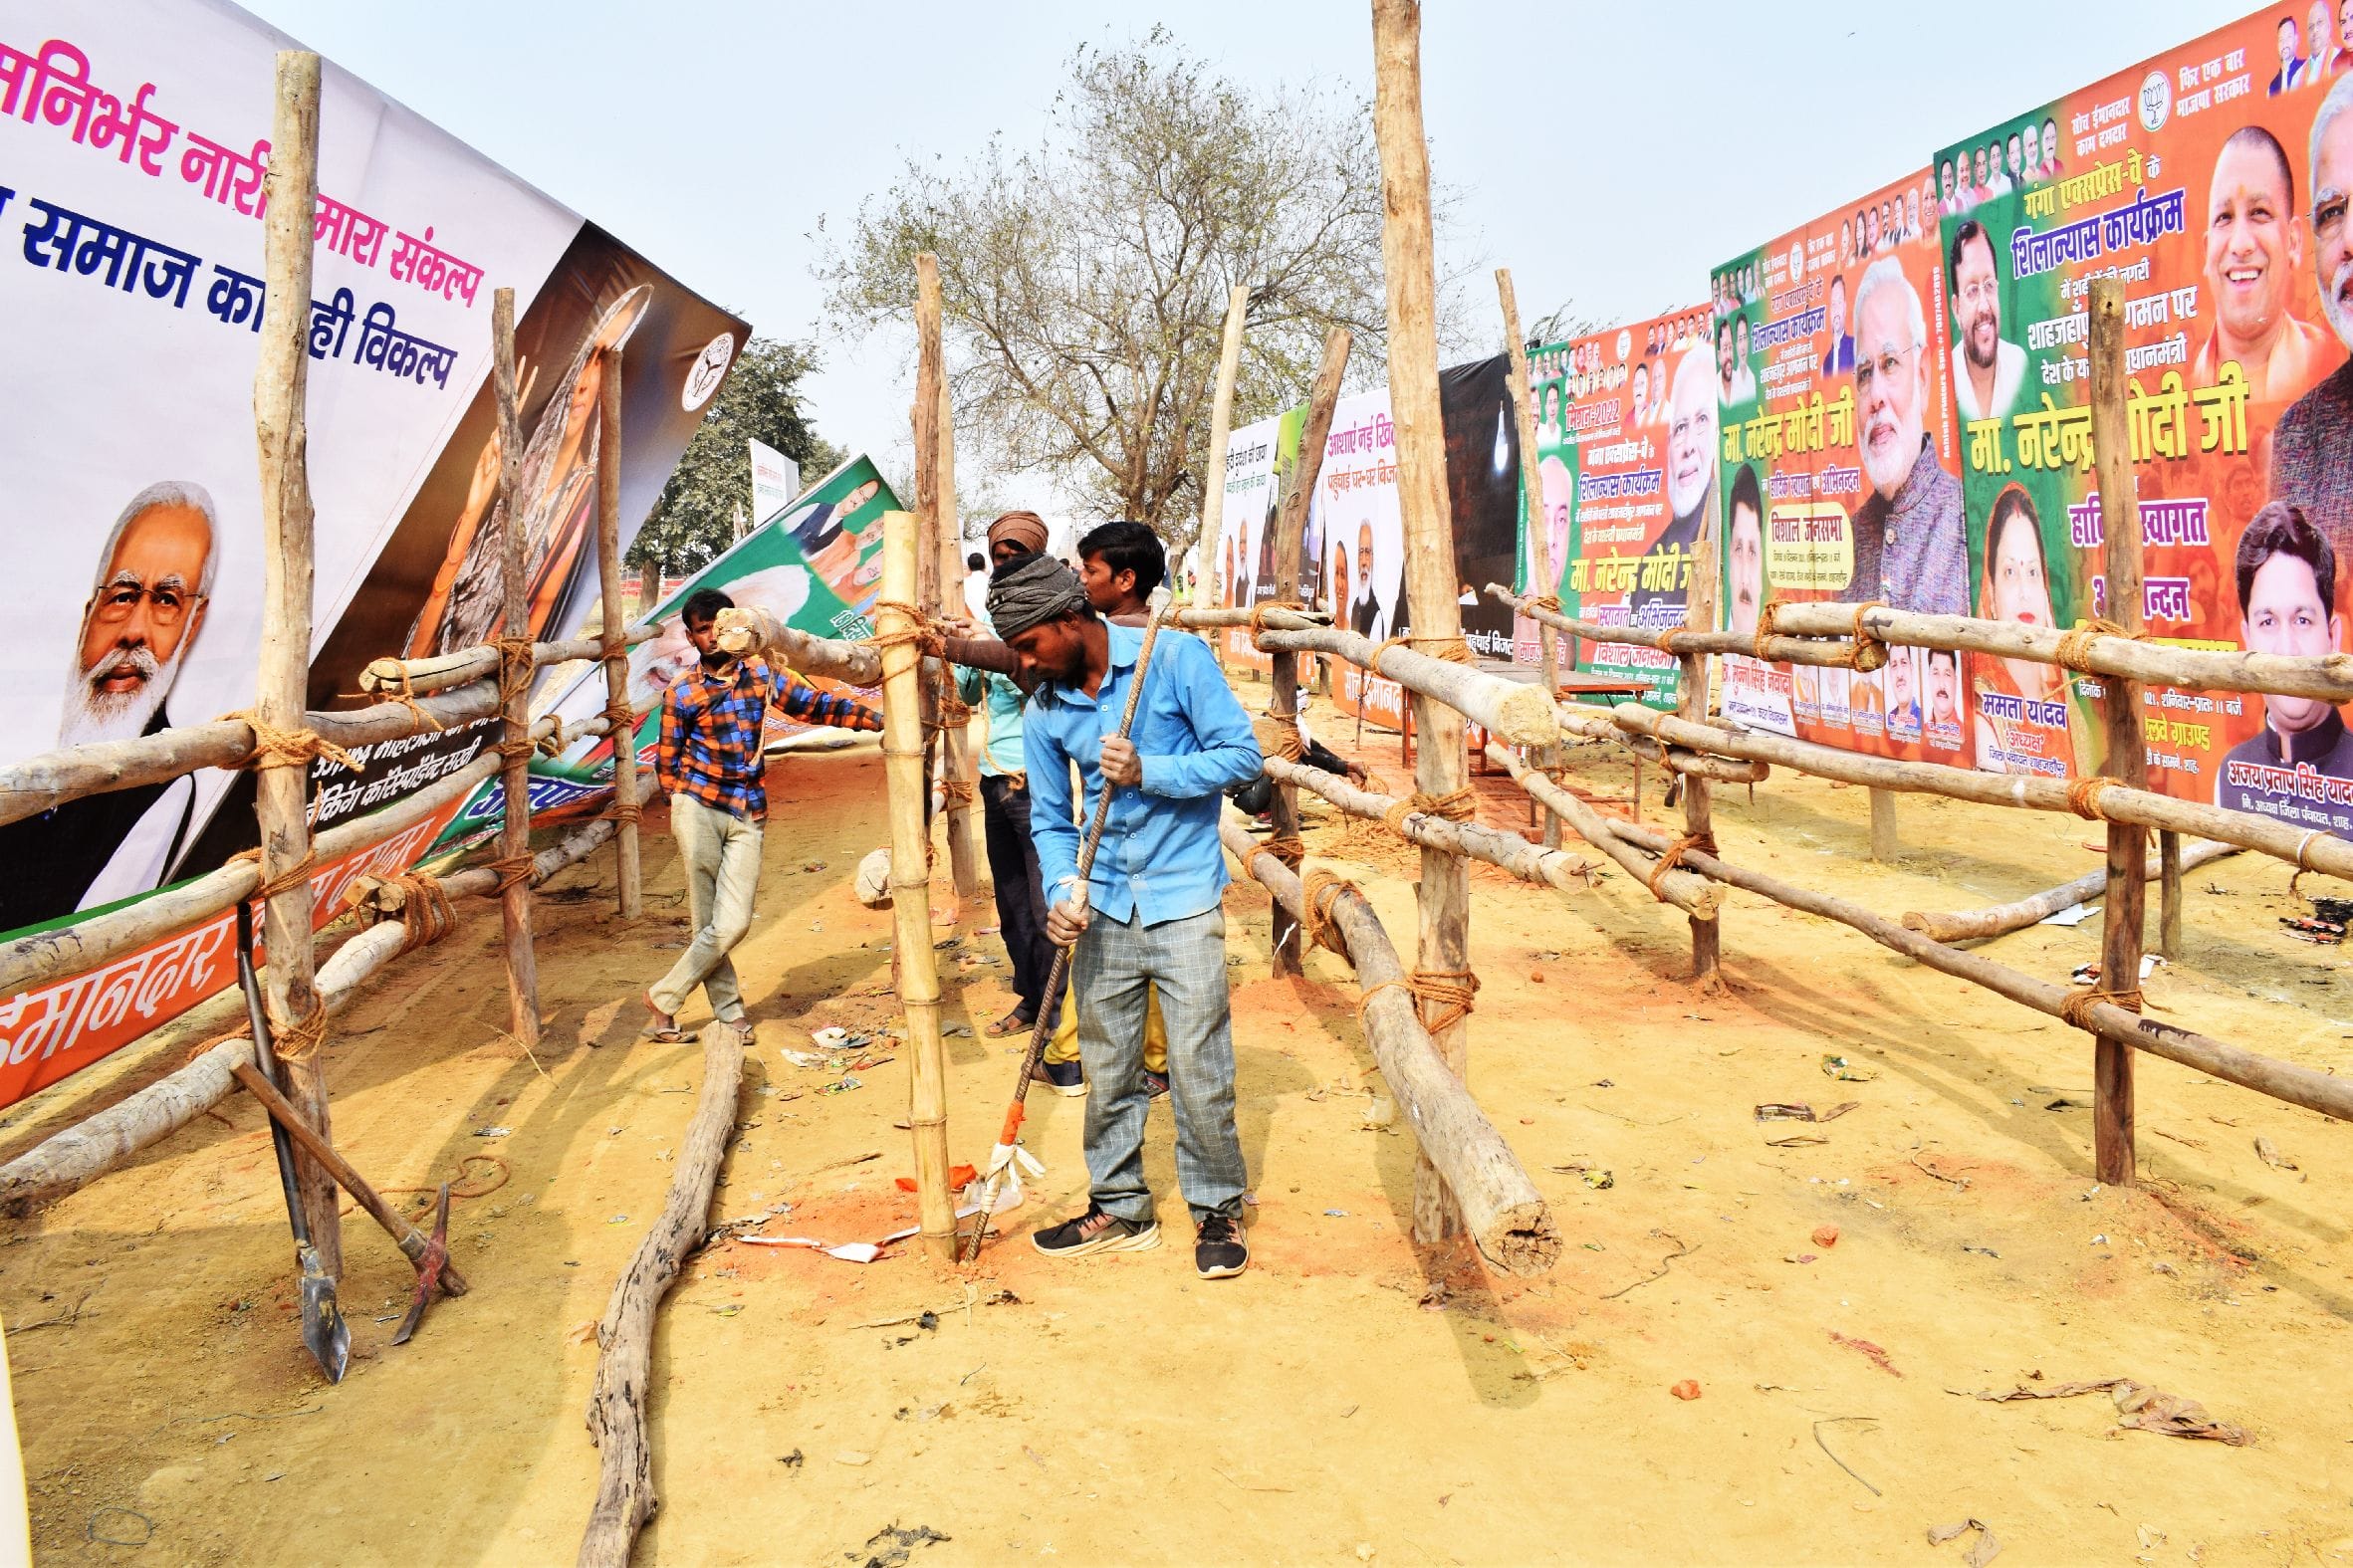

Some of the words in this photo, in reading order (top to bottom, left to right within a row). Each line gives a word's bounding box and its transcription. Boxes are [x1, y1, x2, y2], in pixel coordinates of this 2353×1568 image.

[2179, 66, 2200, 92] फिर
[2202, 57, 2223, 82] एक
[2225, 48, 2245, 72] बार
[2072, 113, 2090, 136] सोच
[2092, 97, 2130, 129] ईमानदार
[2176, 89, 2211, 117] भाजपा
[2214, 73, 2251, 104] सरकार
[2076, 136, 2096, 157] काम
[2098, 122, 2127, 148] दमदार
[2023, 183, 2055, 220] गंगा
[2146, 154, 2161, 179] के
[2010, 215, 2103, 280] शिलान्यास
[2103, 186, 2186, 251] कार्यक्रम
[389, 226, 485, 309] संकल्प
[23, 197, 202, 310] समाज
[206, 263, 266, 334] का
[353, 302, 459, 390] विकल्प
[2171, 285, 2198, 319] पर
[1752, 322, 1789, 353] शिलान्यास
[1789, 305, 1826, 339] कार्यक्रम
[2041, 358, 2061, 385] देश
[2061, 354, 2075, 381] के
[1724, 424, 1744, 463] मा.
[1745, 405, 1783, 461] नरेन्द्र
[1784, 391, 1825, 454] मोदी
[1826, 384, 1854, 447] जी
[2193, 359, 2249, 455] जी
[1327, 420, 1356, 457] आशाएं
[1358, 414, 1373, 453] नई
[1352, 468, 1376, 489] घर-घर
[1578, 472, 1621, 502] शिलान्यास
[1621, 464, 1662, 498] कार्यक्रम
[1771, 512, 1799, 542] विशाल
[1803, 516, 1842, 542] जनसभा
[1570, 559, 1590, 593] मा.
[1595, 546, 1641, 593] नरेन्द्र
[1641, 542, 1680, 592] मोदी
[1983, 693, 2023, 721] ममता
[2025, 700, 2067, 729] यादव
[2225, 696, 2242, 716] बजे
[1989, 746, 2004, 762] जिला
[2228, 760, 2262, 789] अजय
[2262, 765, 2296, 796] प्रताप
[2296, 761, 2325, 803] सिंह
